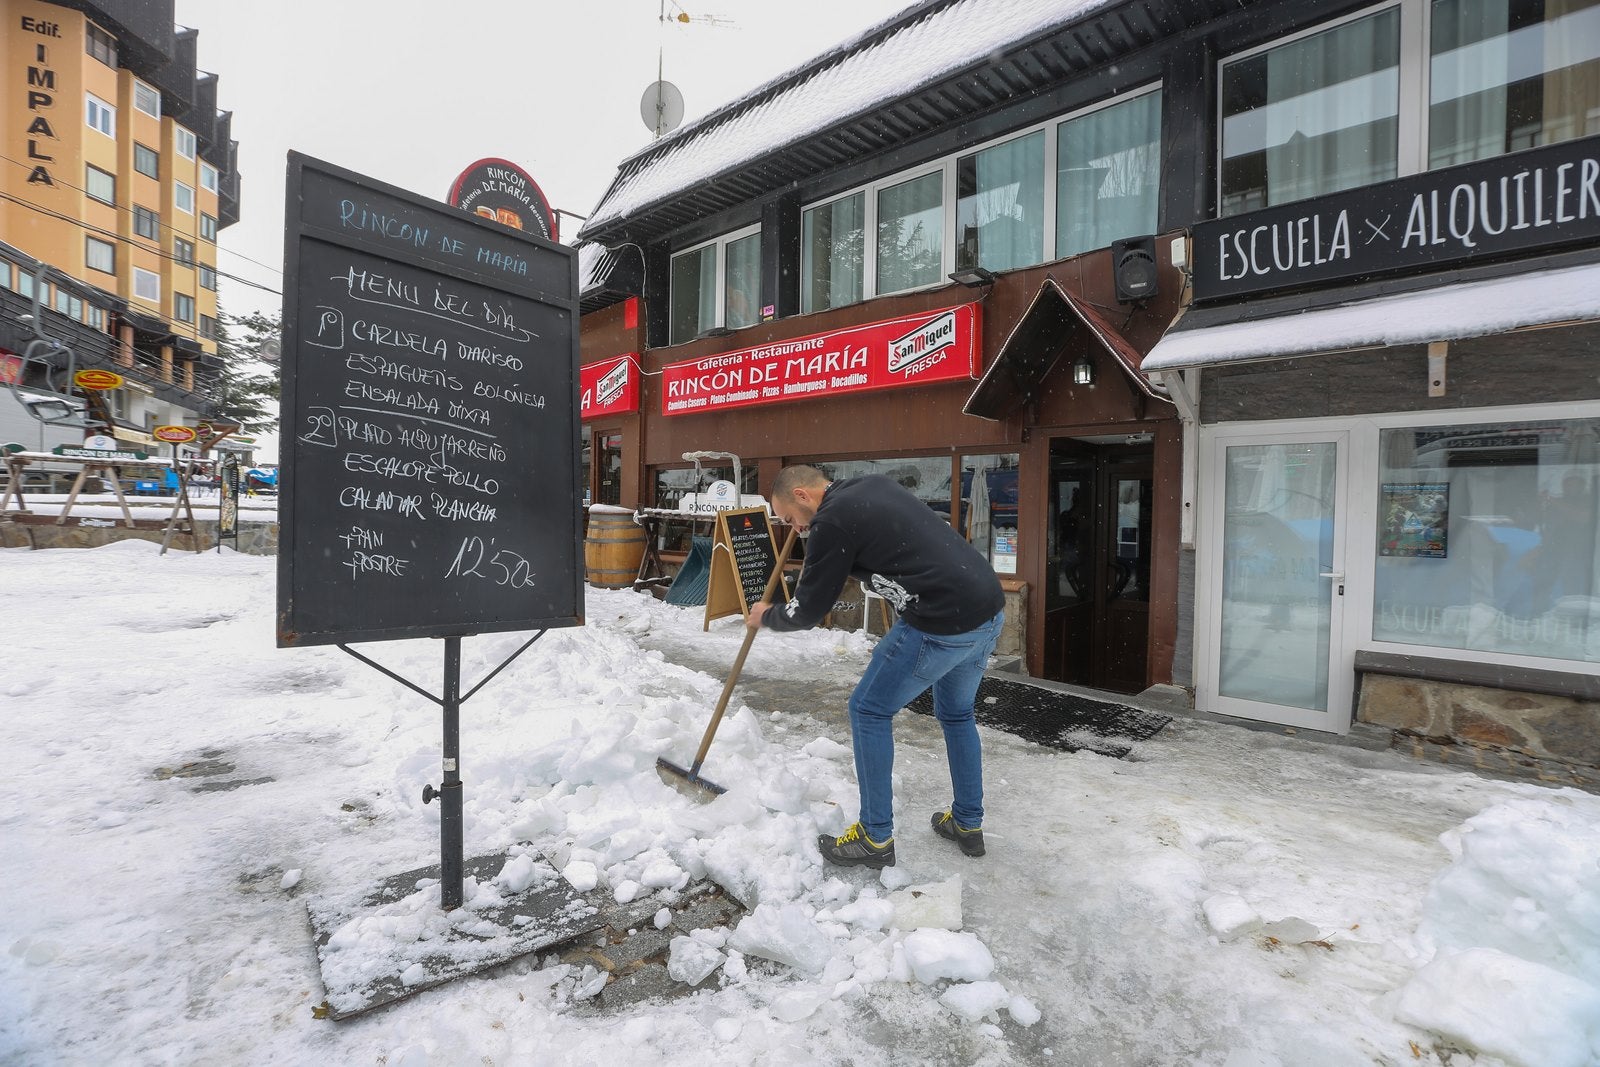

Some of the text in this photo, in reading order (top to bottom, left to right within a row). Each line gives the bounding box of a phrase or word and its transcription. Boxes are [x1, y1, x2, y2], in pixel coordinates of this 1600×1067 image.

[21, 15, 62, 38] Edif.
[27, 43, 58, 188] IMPALA
[481, 180, 531, 205] DE MARÍA
[487, 167, 526, 189] RINCÓN
[340, 200, 528, 277] RINCON DE MARIA
[1219, 158, 1600, 281] ESCUELA ALQUILER
[348, 265, 420, 305] MENU
[434, 287, 474, 317] DEL
[351, 319, 448, 361] CAZUELA
[751, 339, 825, 360] Restaurante
[668, 344, 868, 397] RINCÓN DE MARÍA
[904, 349, 947, 379] FRESCA
[344, 379, 441, 415] ENSALADA
[667, 400, 688, 411] Comidas
[710, 394, 726, 405] Platos
[726, 388, 759, 402] Combinados
[762, 385, 780, 397] Pizzas
[783, 379, 827, 394] Hamburguesa
[831, 372, 868, 388] Bocadillos
[337, 416, 393, 445] PLATO
[343, 452, 499, 495] ESCALOPE POLLO
